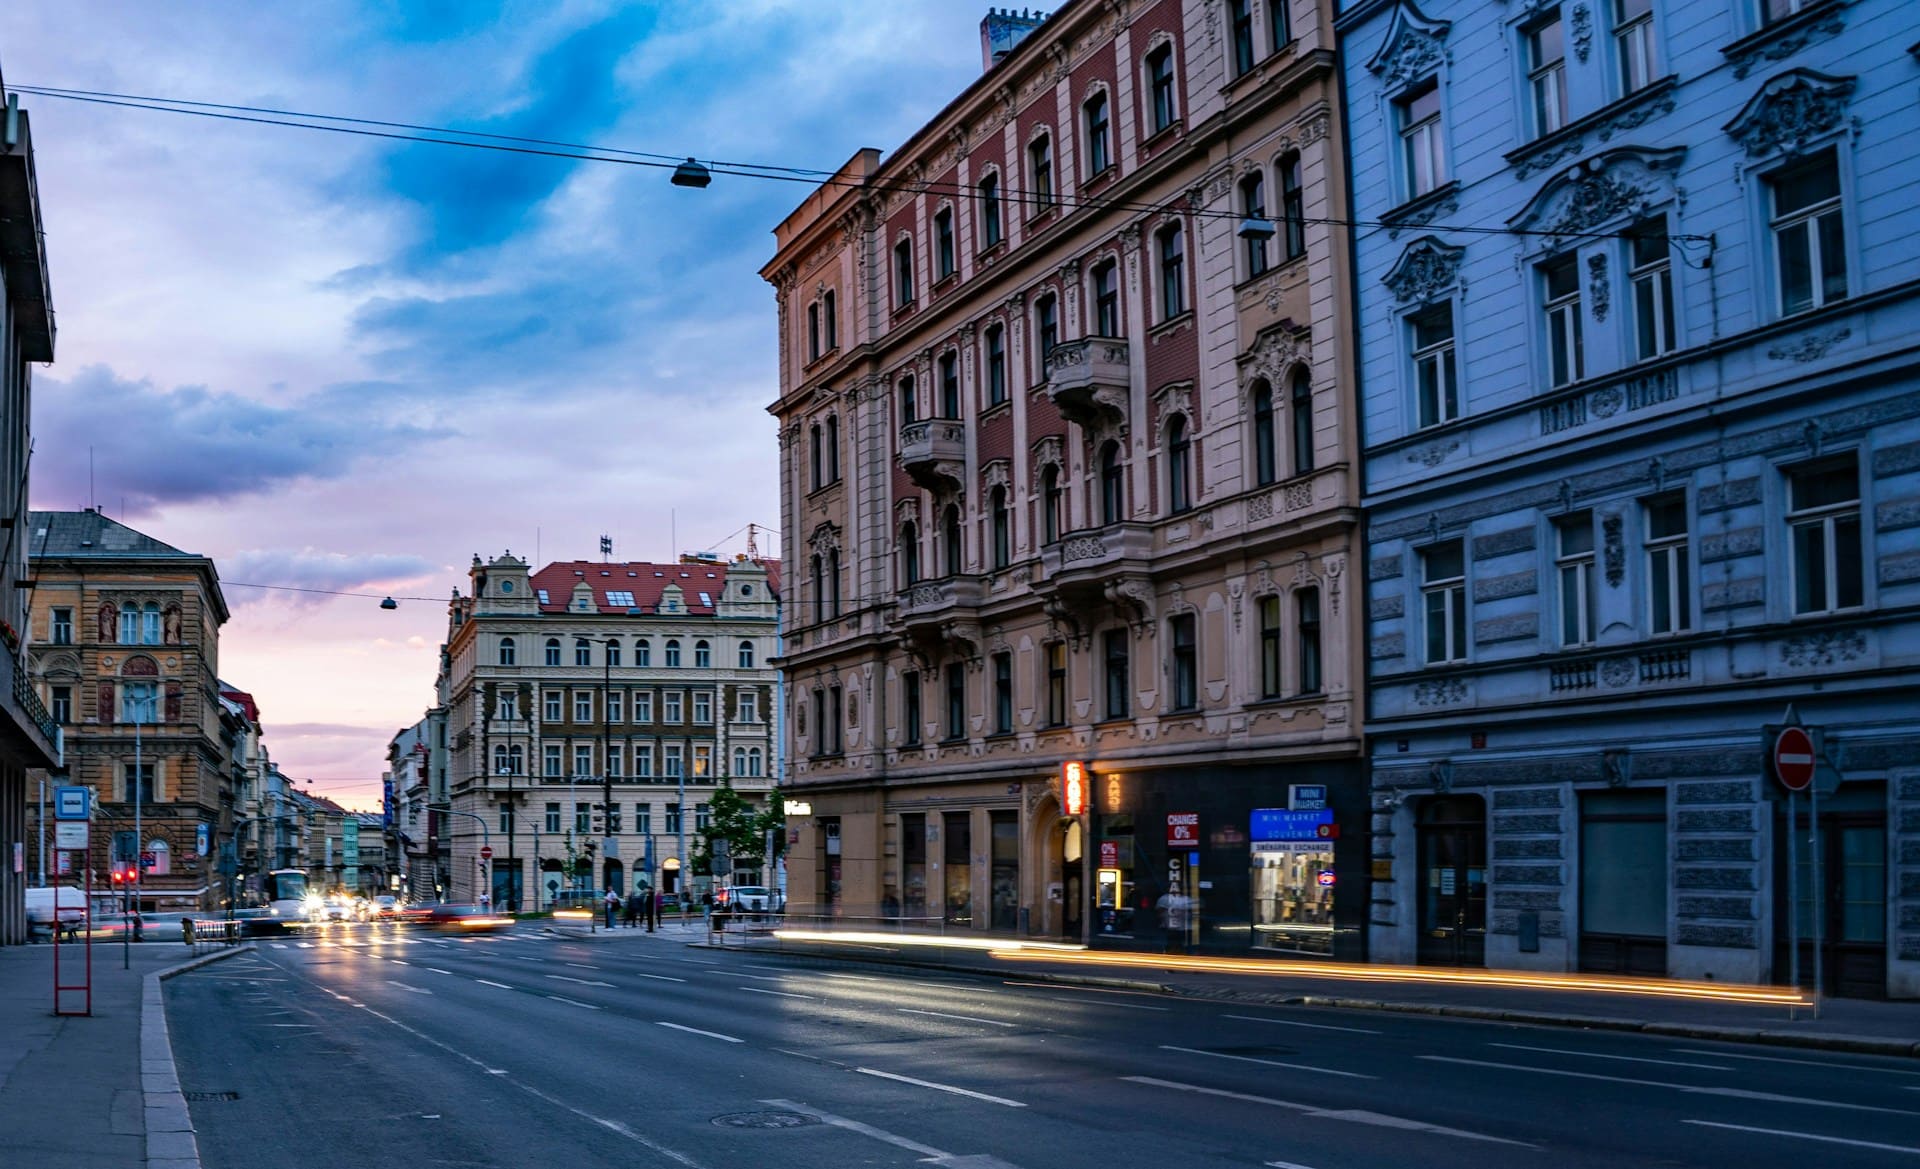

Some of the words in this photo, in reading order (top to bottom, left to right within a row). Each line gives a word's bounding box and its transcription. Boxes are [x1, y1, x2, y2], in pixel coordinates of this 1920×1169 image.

[1300, 789, 1320, 798] MINI
[1167, 814, 1198, 826] CHANGE
[1284, 813, 1320, 821] MARKET
[1174, 826, 1190, 839] 0%
